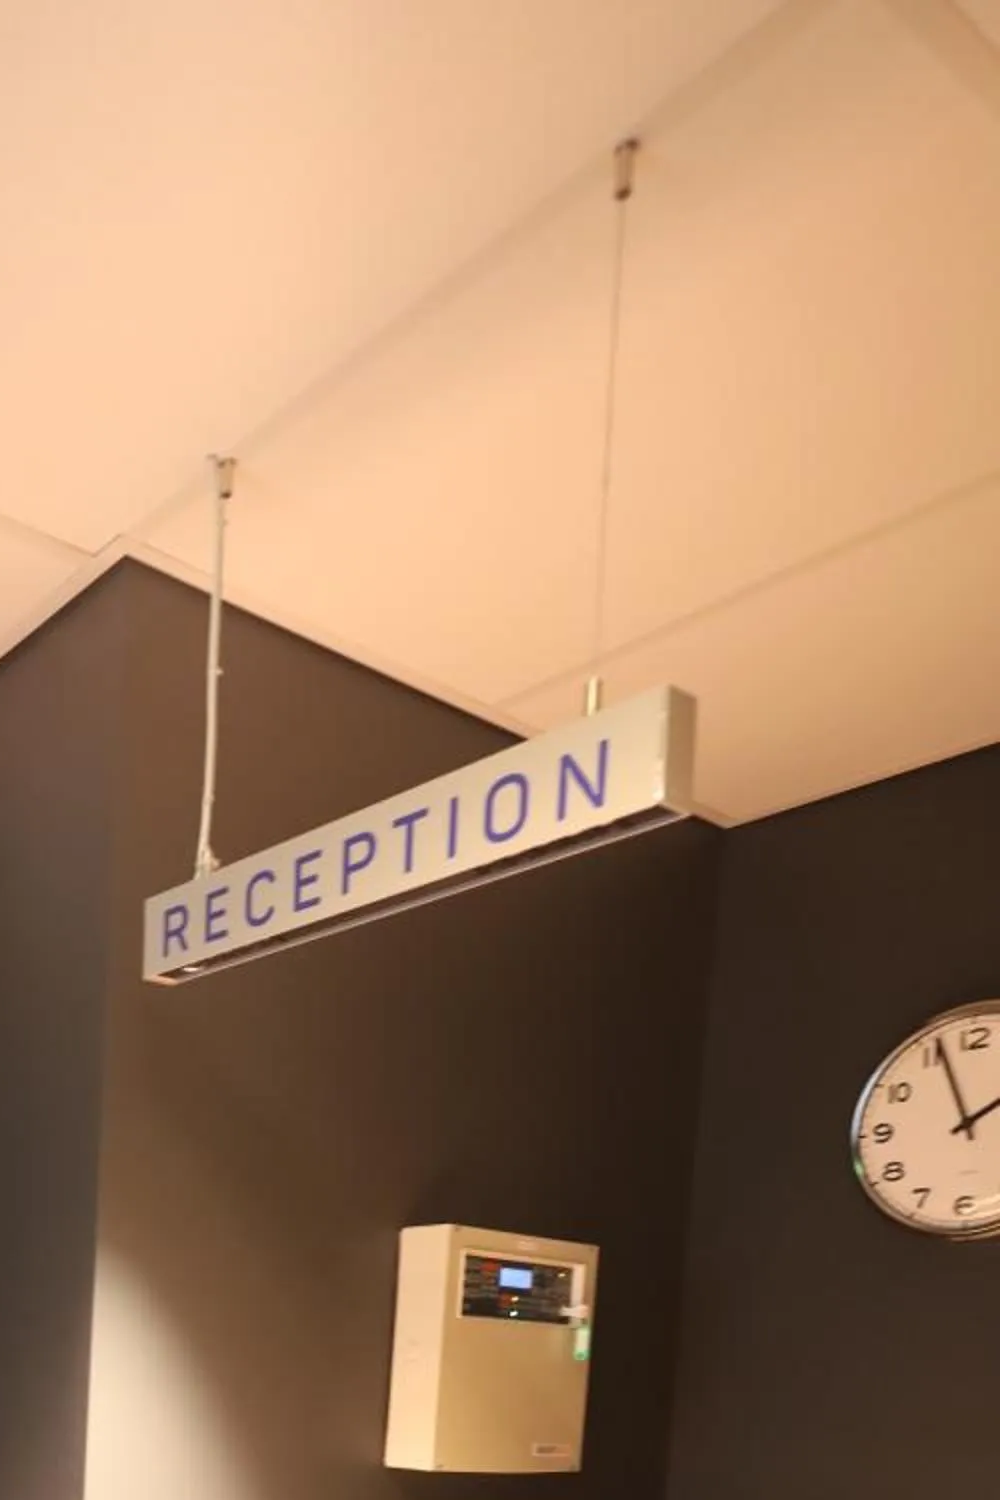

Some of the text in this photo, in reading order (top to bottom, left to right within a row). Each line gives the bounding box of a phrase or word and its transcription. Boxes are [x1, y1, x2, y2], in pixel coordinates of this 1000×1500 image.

[160, 739, 608, 958] RECEPTION
[960, 1027, 991, 1051] 12
[887, 1082, 911, 1104] 10
[873, 1123, 893, 1143] 9
[883, 1161, 905, 1182] 8
[912, 1187, 931, 1208] 7
